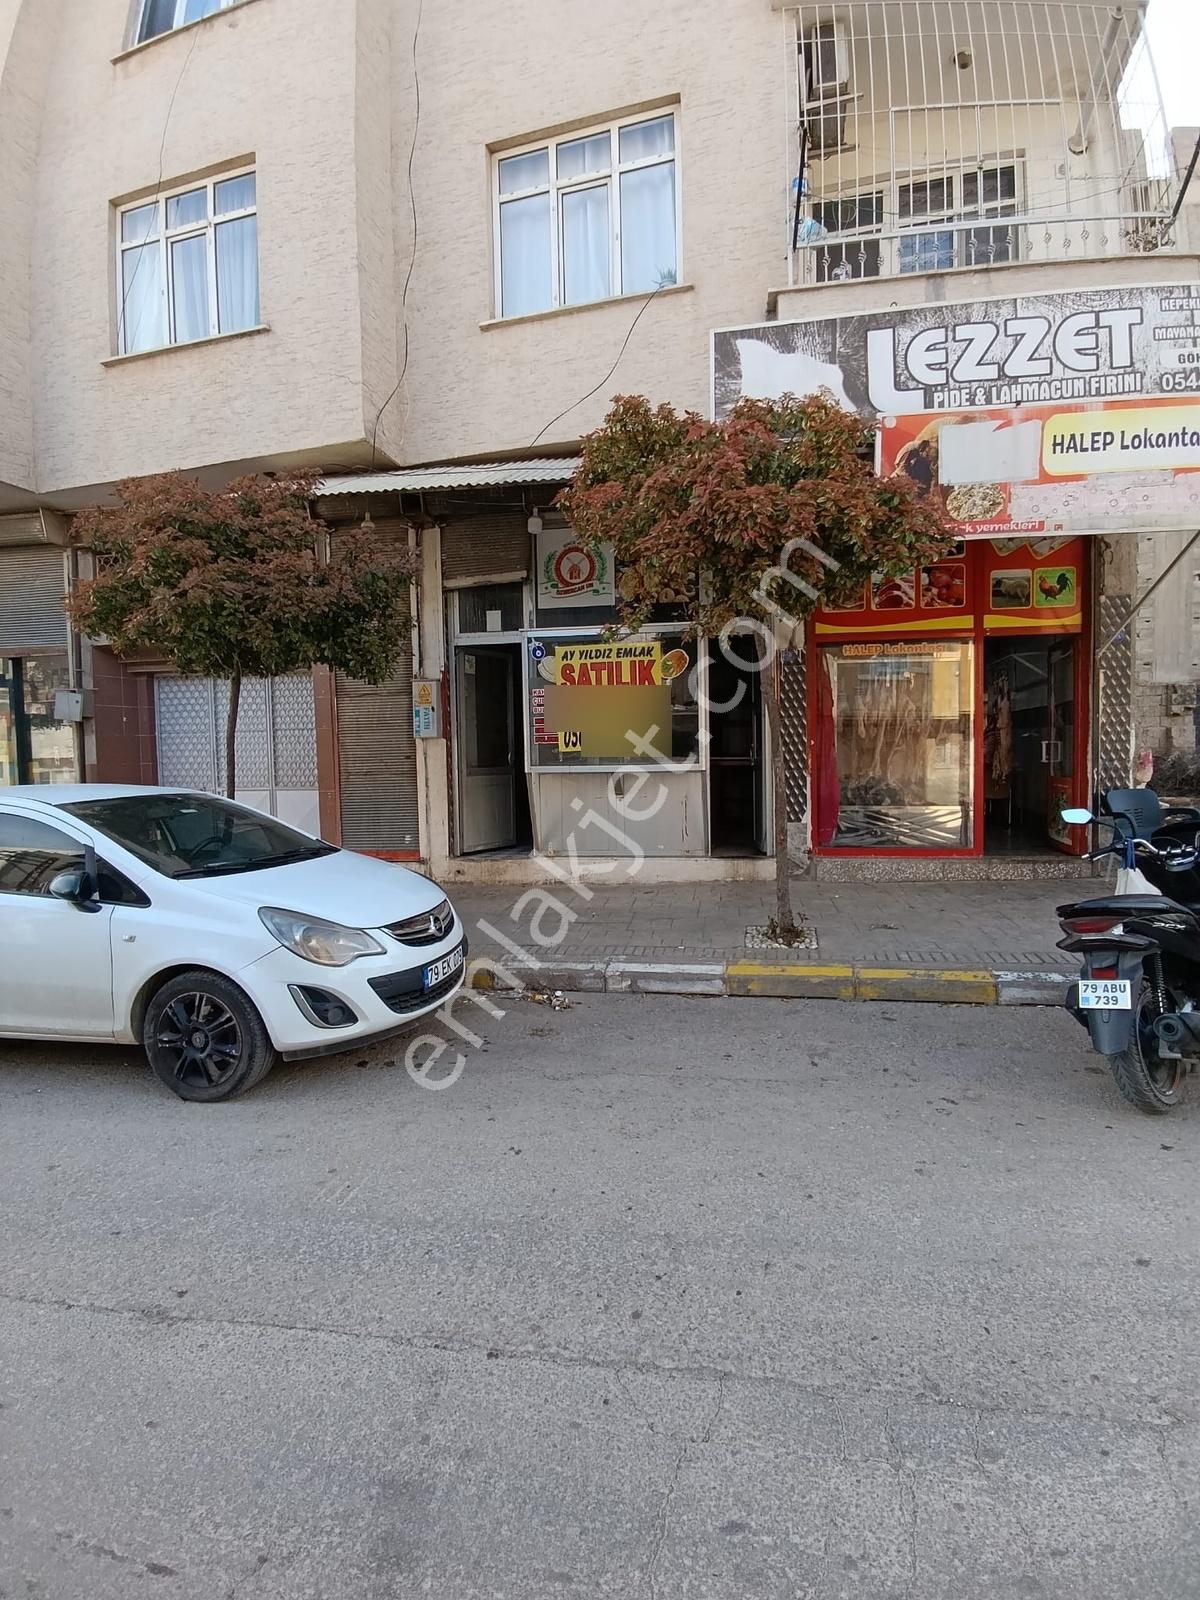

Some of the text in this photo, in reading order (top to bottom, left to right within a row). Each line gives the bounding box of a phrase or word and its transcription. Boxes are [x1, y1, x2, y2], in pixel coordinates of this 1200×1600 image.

[867, 308, 1143, 410] LEZZET
[975, 388, 986, 405] &
[991, 377, 1085, 404] LAHMACUN
[1090, 373, 1142, 396] FIRINI
[1161, 372, 1200, 391] 054
[1052, 426, 1200, 454] HALEP Lokanta
[561, 646, 655, 661] AY YILDIZ EMLAK
[843, 644, 883, 655] HALEP
[560, 659, 656, 685] SATILIK
[428, 965, 439, 984] 79
[442, 956, 452, 976] EK
[1083, 983, 1127, 993] 79 ABU
[1095, 995, 1119, 1005] 739
